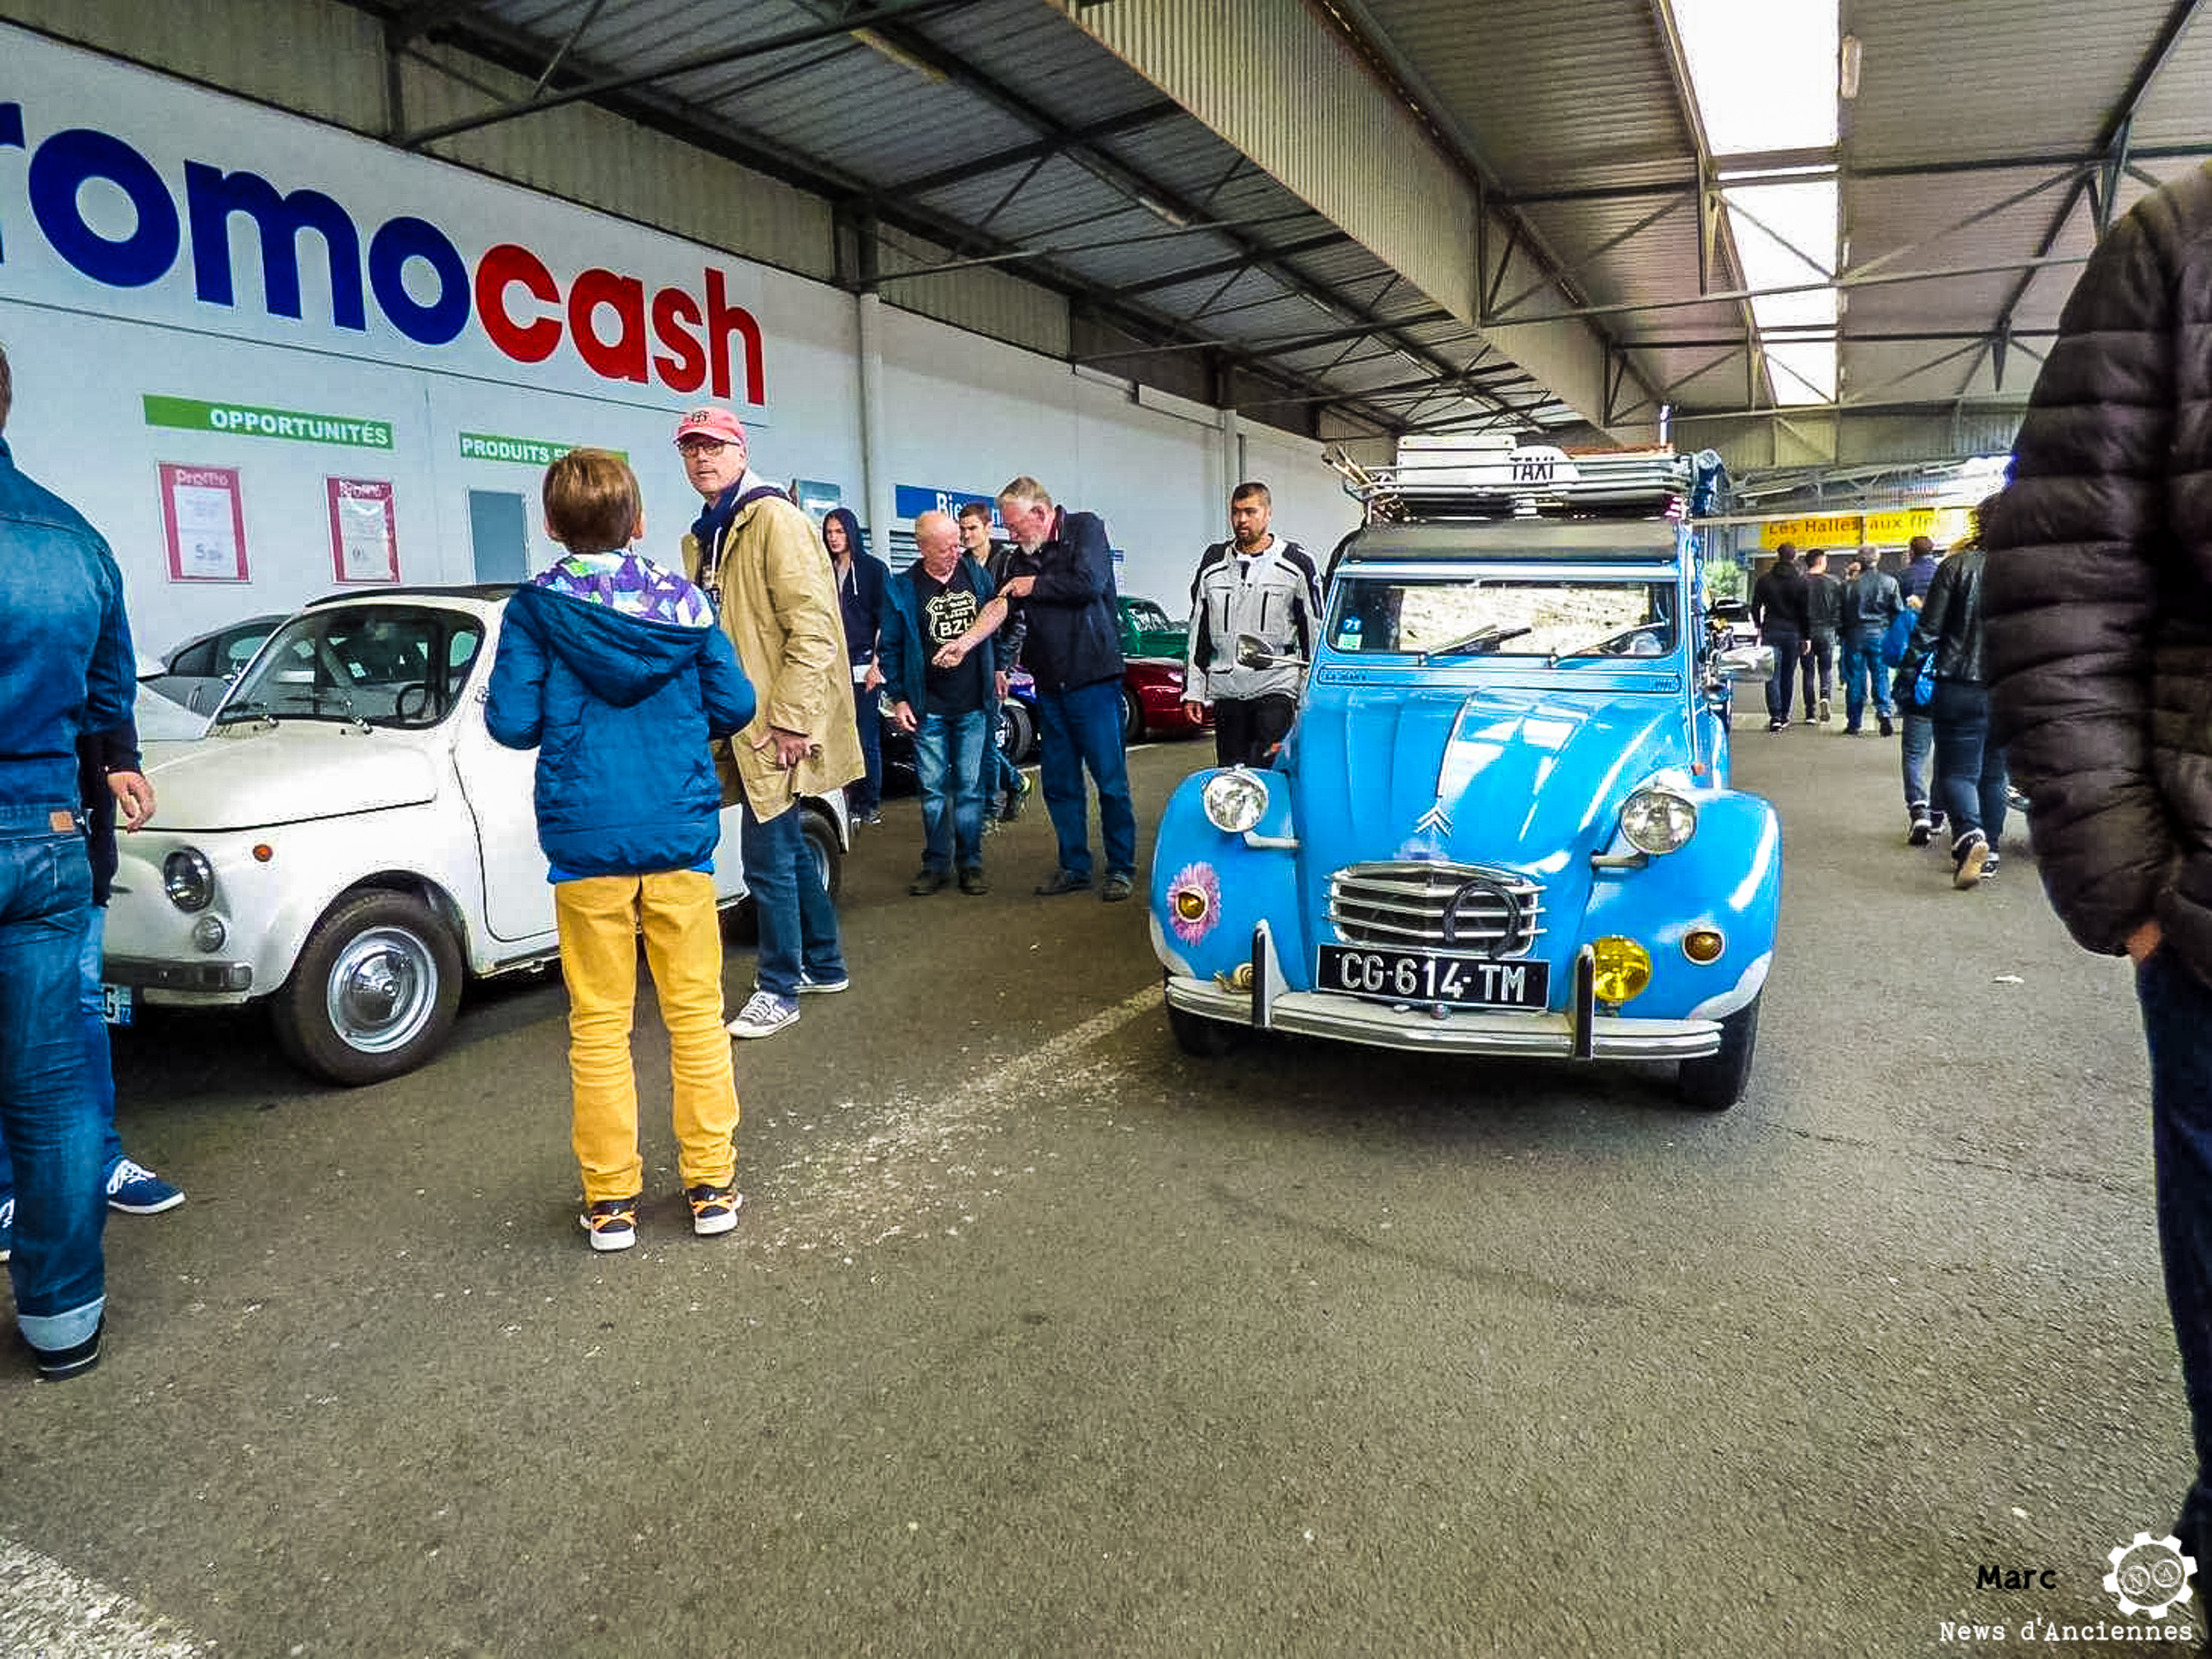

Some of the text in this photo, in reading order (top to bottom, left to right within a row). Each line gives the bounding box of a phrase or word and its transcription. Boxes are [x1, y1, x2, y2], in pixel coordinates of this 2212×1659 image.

[210, 408, 388, 446] OPPORTUNITÉS
[462, 437, 549, 463] PRODUITS
[1509, 456, 1555, 481] TAXI
[1340, 952, 1526, 1003] CG-614-TM
